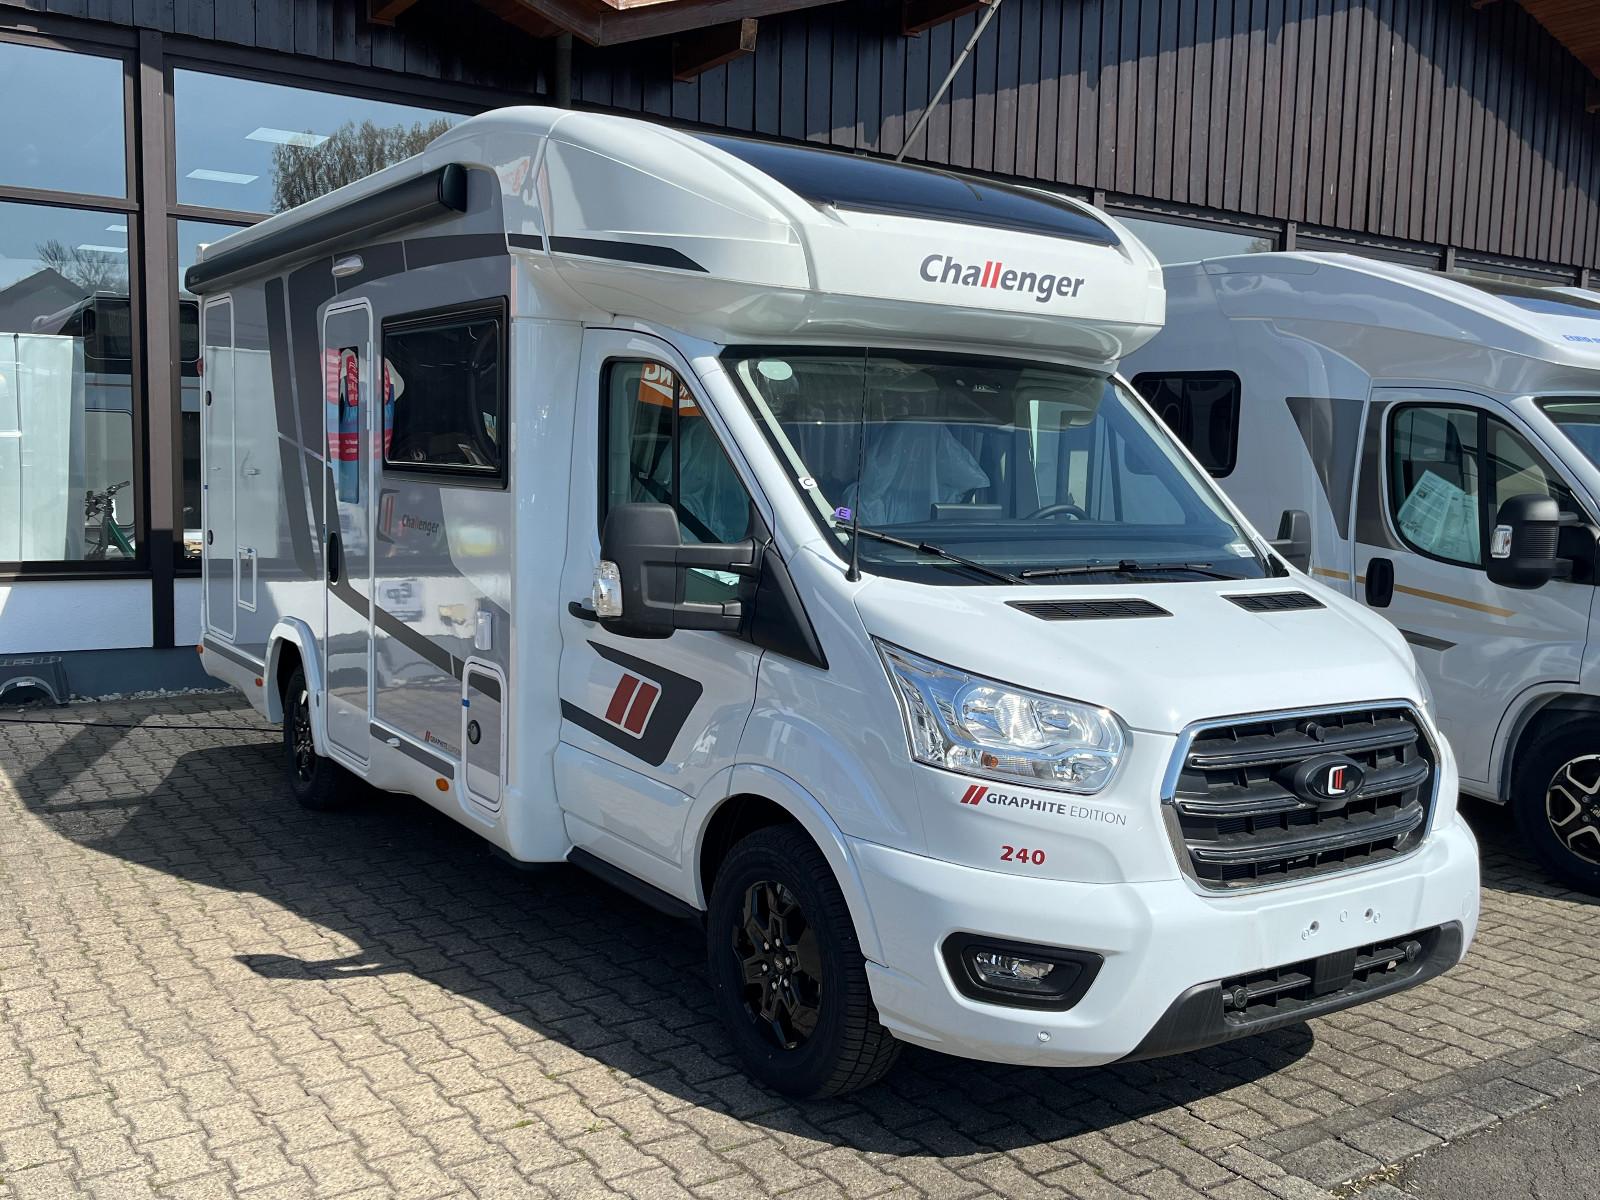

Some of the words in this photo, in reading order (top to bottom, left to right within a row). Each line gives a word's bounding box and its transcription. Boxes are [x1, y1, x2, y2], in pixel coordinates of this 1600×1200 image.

[919, 253, 1085, 304] Challenger
[401, 513, 440, 536] Challenger
[986, 792, 1067, 815] GRAPHITE
[1070, 805, 1127, 826] EDITION
[1000, 845, 1046, 866] 240
